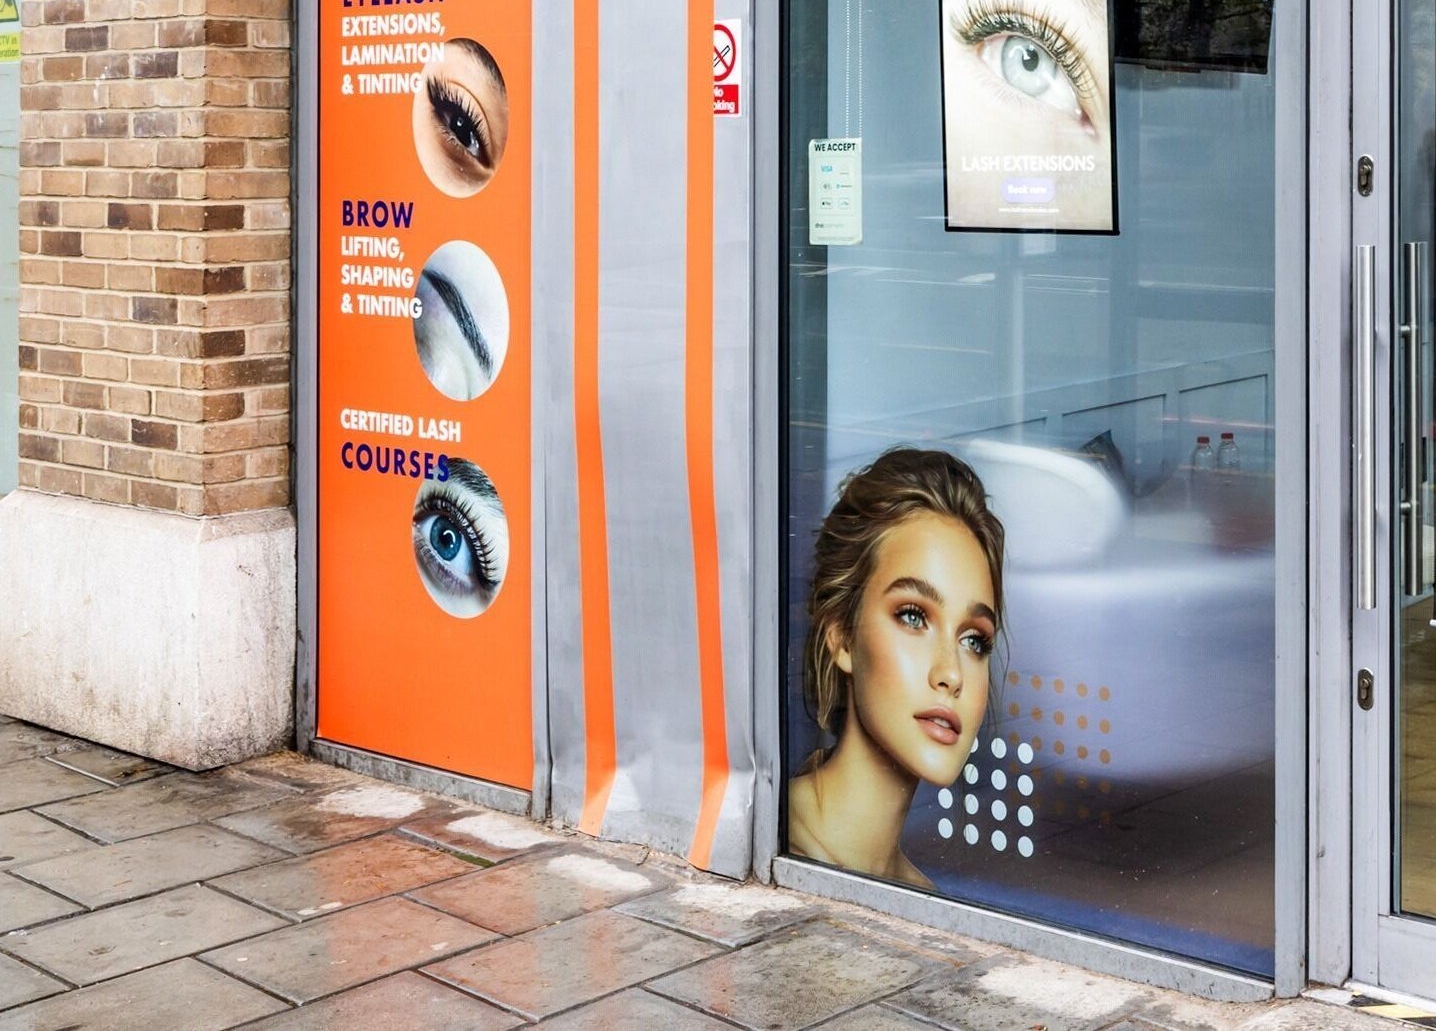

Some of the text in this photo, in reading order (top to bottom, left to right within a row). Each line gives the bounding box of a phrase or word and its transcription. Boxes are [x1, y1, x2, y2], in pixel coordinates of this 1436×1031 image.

[341, 12, 446, 37] EXTENSIONS,
[341, 41, 445, 66] LAMINATION
[341, 72, 423, 95] & TINTING
[815, 143, 855, 152] WE ACCEPT
[962, 154, 1095, 172] LASH EXTENSIONS
[342, 200, 414, 229] BROW
[341, 236, 405, 261] LIFTING,
[341, 264, 414, 288] SHAPING
[341, 292, 423, 319] & TINTING
[341, 408, 461, 442] CERTIFIED LASH
[341, 441, 450, 482] COURSES
